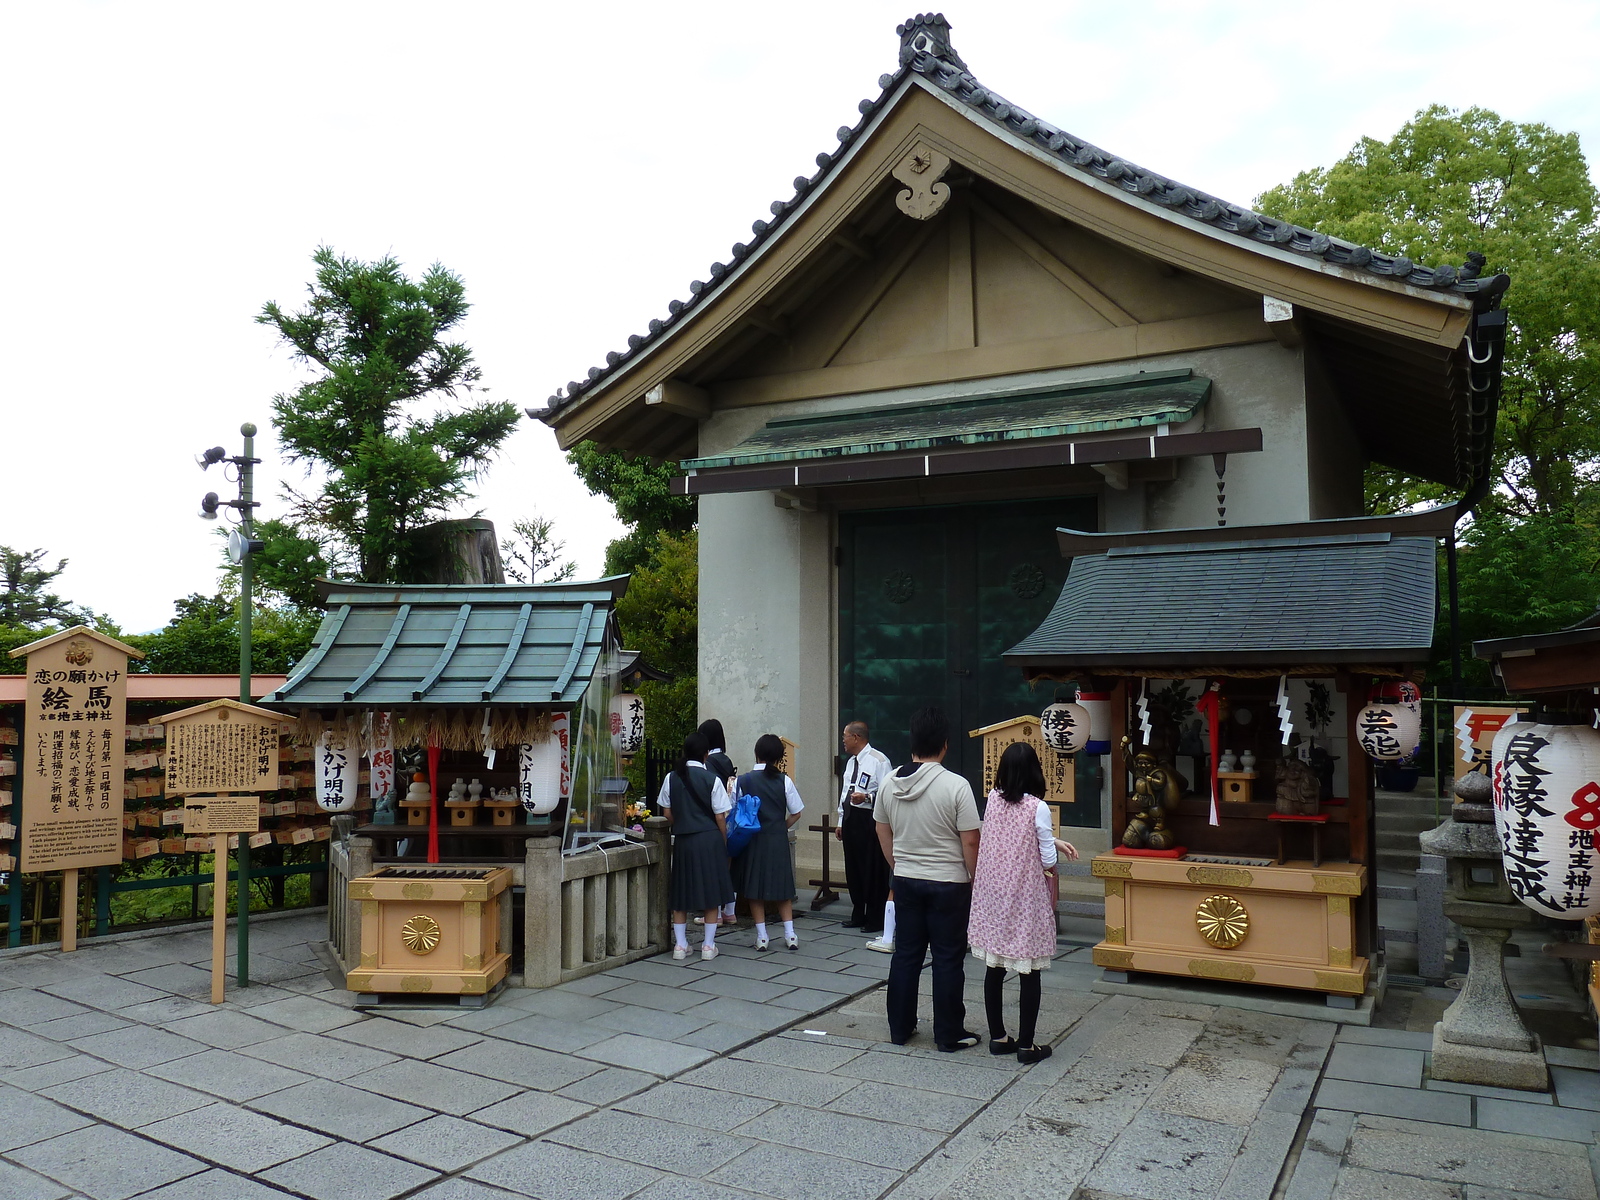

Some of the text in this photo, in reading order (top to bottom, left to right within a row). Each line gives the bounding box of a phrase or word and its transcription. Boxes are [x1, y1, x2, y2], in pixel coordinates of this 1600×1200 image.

[34, 668, 120, 684] 恋の願かけ
[41, 686, 112, 710] 絵馬
[36, 732, 48, 778] いたします。
[258, 726, 270, 776] おかげ明神
[1041, 710, 1078, 750] 勝運
[1360, 710, 1401, 756] 芸能
[50, 730, 64, 814] 開運招福のご祈願を
[68, 730, 81, 812] 縁結び、恋愛成就、
[84, 729, 96, 811] えんむすび地主祭りで
[100, 729, 112, 810] 毎月第一日曜日の
[1502, 732, 1567, 912] 良縁達成
[1562, 830, 1593, 909] 地主神社
